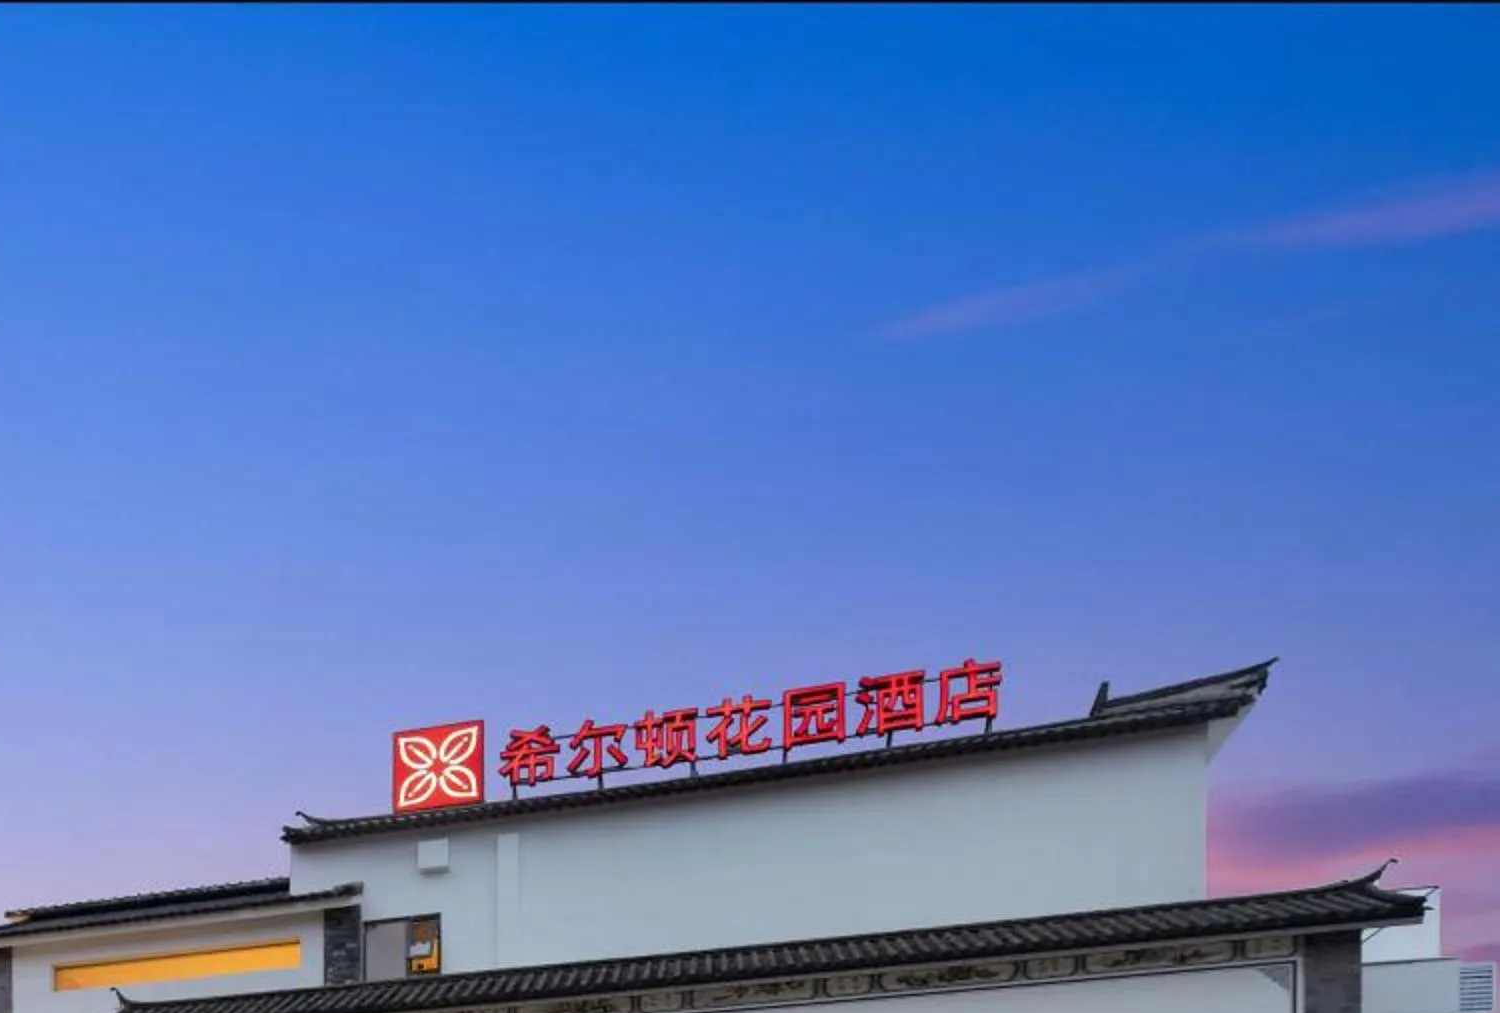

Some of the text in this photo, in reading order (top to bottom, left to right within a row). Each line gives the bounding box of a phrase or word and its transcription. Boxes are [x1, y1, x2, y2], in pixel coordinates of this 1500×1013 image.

[498, 658, 1002, 786] 希尔顿花园酒店
